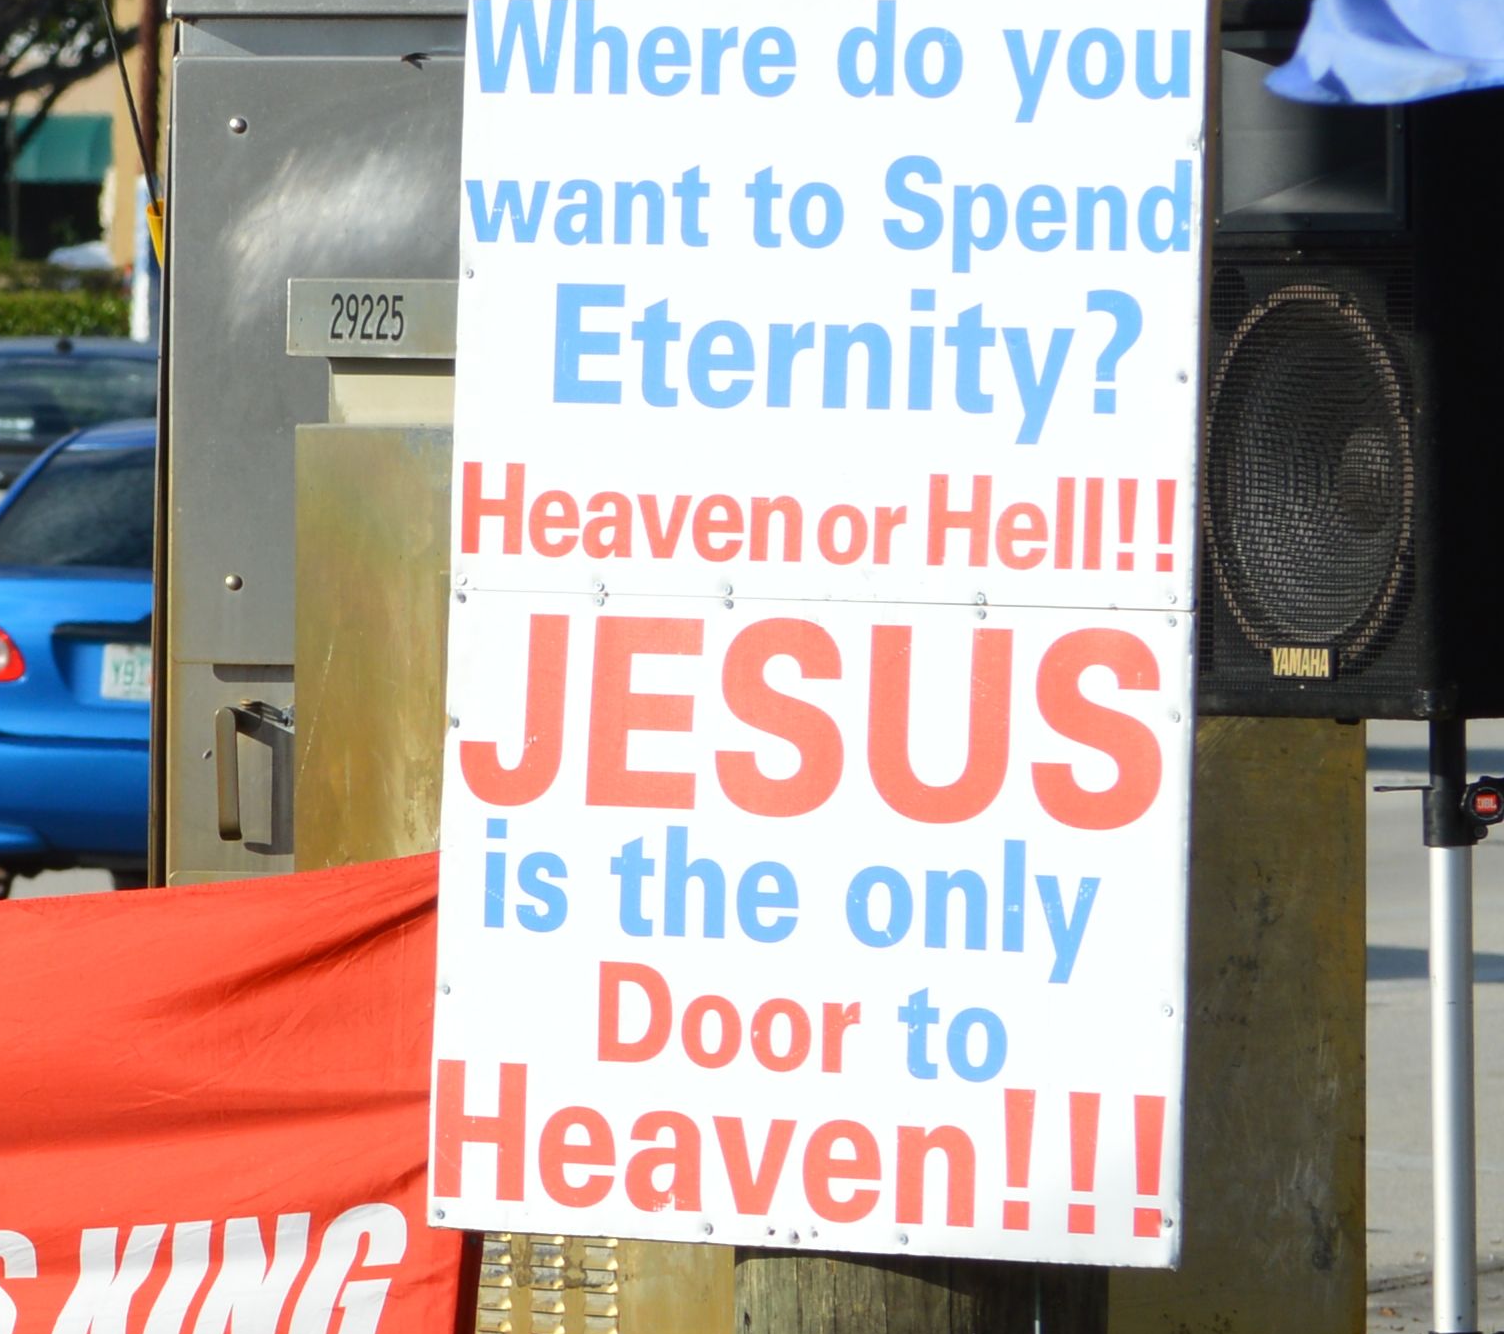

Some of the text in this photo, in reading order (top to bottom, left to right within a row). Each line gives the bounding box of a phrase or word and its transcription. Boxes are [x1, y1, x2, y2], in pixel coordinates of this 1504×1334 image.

[475, 0, 1191, 123] Where do you
[468, 157, 1193, 273] want to Spend
[332, 295, 404, 341] 29225
[555, 285, 1143, 444] Eternity?
[463, 463, 1177, 572] Heaven or Hell!!
[460, 614, 1163, 831] JESUS
[1272, 647, 1329, 677] YAMAHA
[486, 819, 1100, 984] is the only
[599, 963, 1008, 1083] Door to
[434, 1058, 1166, 1238] Heaven!!!
